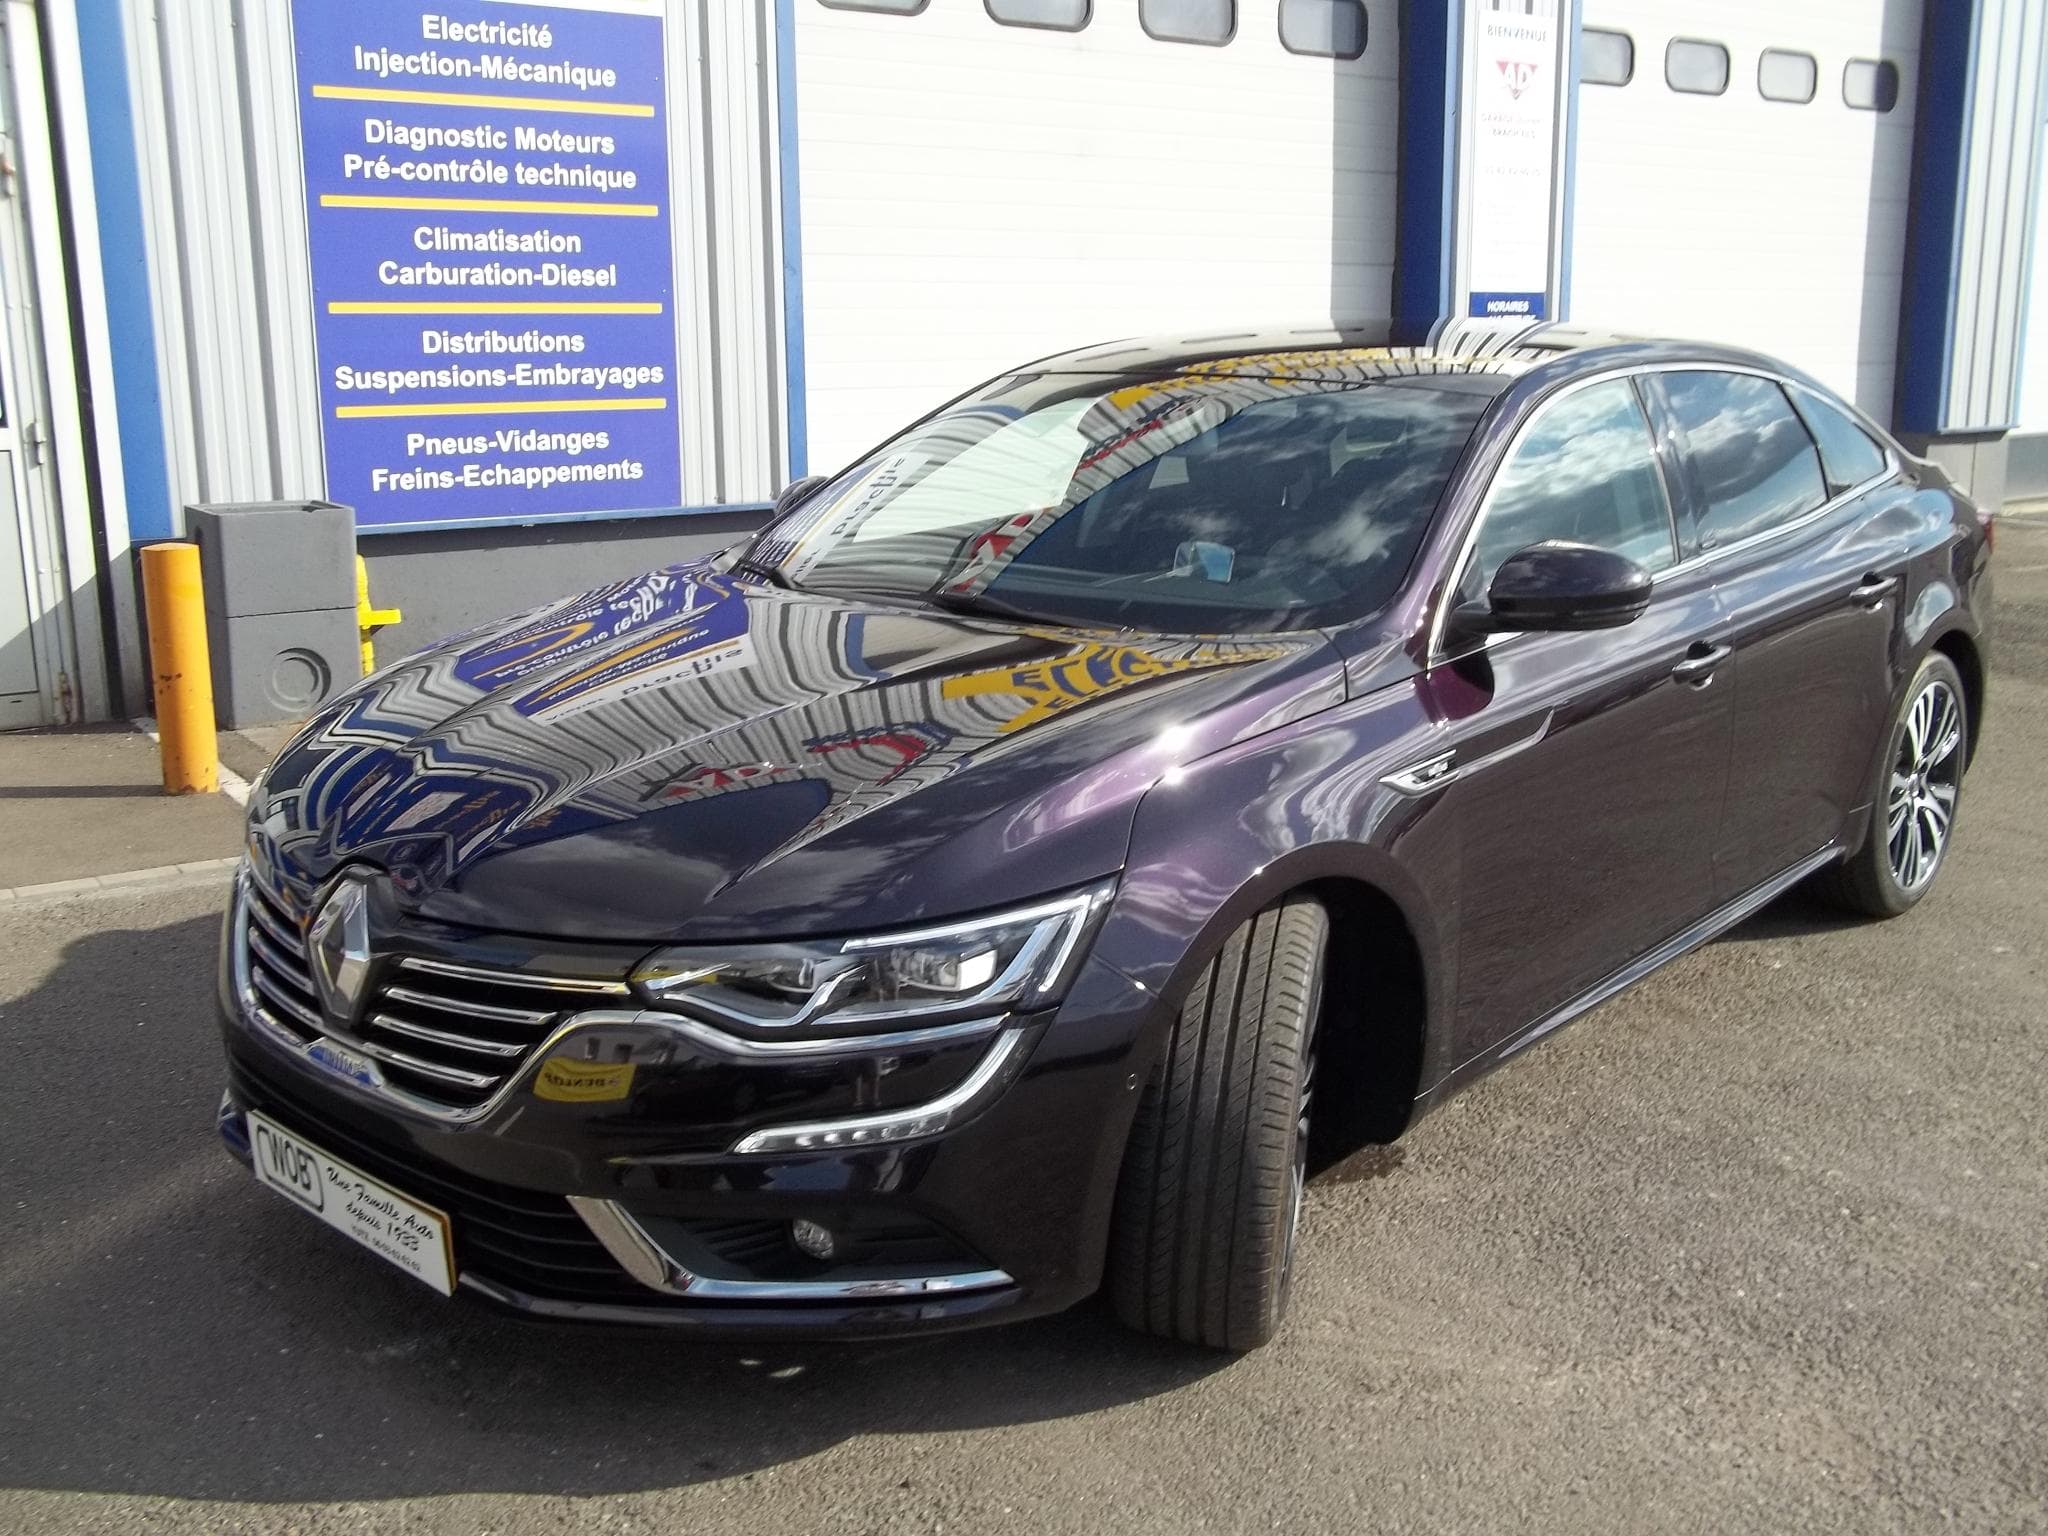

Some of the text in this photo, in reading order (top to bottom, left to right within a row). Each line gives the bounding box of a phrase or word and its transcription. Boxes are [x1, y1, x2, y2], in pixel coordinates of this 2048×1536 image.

[421, 13, 554, 49] Electricité
[1486, 24, 1548, 42] BIENVENUE
[353, 45, 617, 91] Injection-Mécanique
[363, 117, 616, 155] Diagnostic Moteurs
[342, 153, 637, 194] Pré-contrôle technique
[412, 225, 582, 254] Climatisation
[377, 260, 618, 288] Carburation-Diesel
[421, 330, 586, 355] Distributions
[334, 362, 665, 394] Suspensions-Embrayages
[406, 428, 610, 457] Pneus-Vidanges
[371, 458, 644, 492] Freins-Echappements
